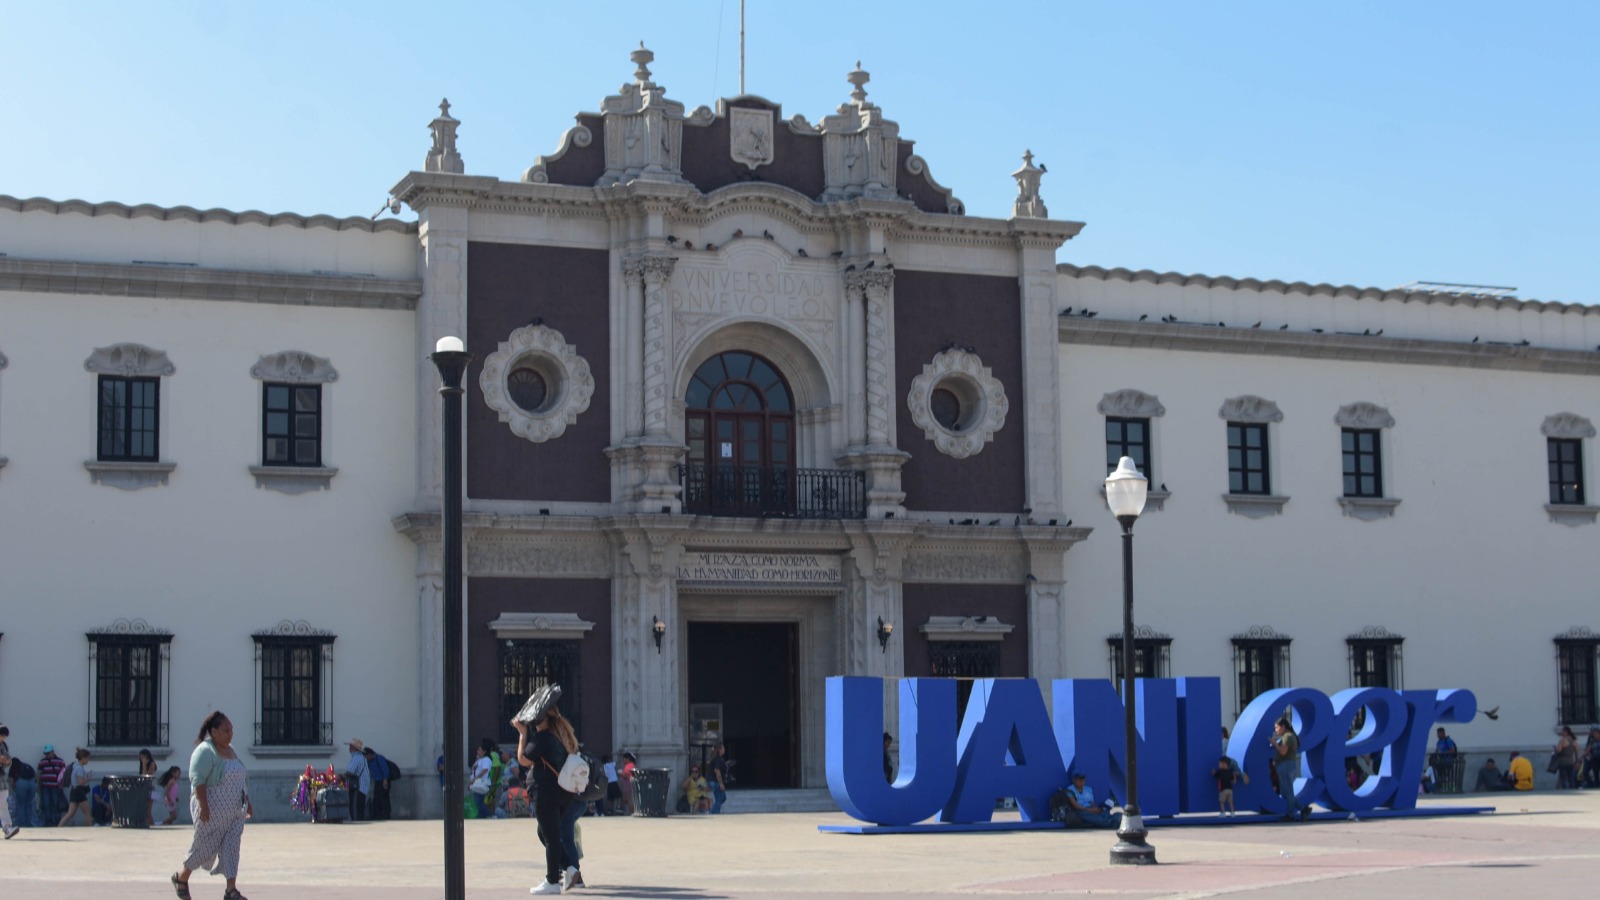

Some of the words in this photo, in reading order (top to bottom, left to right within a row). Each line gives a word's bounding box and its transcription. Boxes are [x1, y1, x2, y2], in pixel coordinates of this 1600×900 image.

[683, 269, 825, 297] VNIVERSIDAD
[688, 291, 768, 315] NVEVO
[772, 296, 835, 319] LEON
[698, 554, 710, 565] MI
[713, 554, 749, 567] RAZA
[751, 554, 778, 567] COMO
[780, 555, 819, 567] NORMA
[678, 567, 691, 578] LA
[761, 568, 789, 580] COMO
